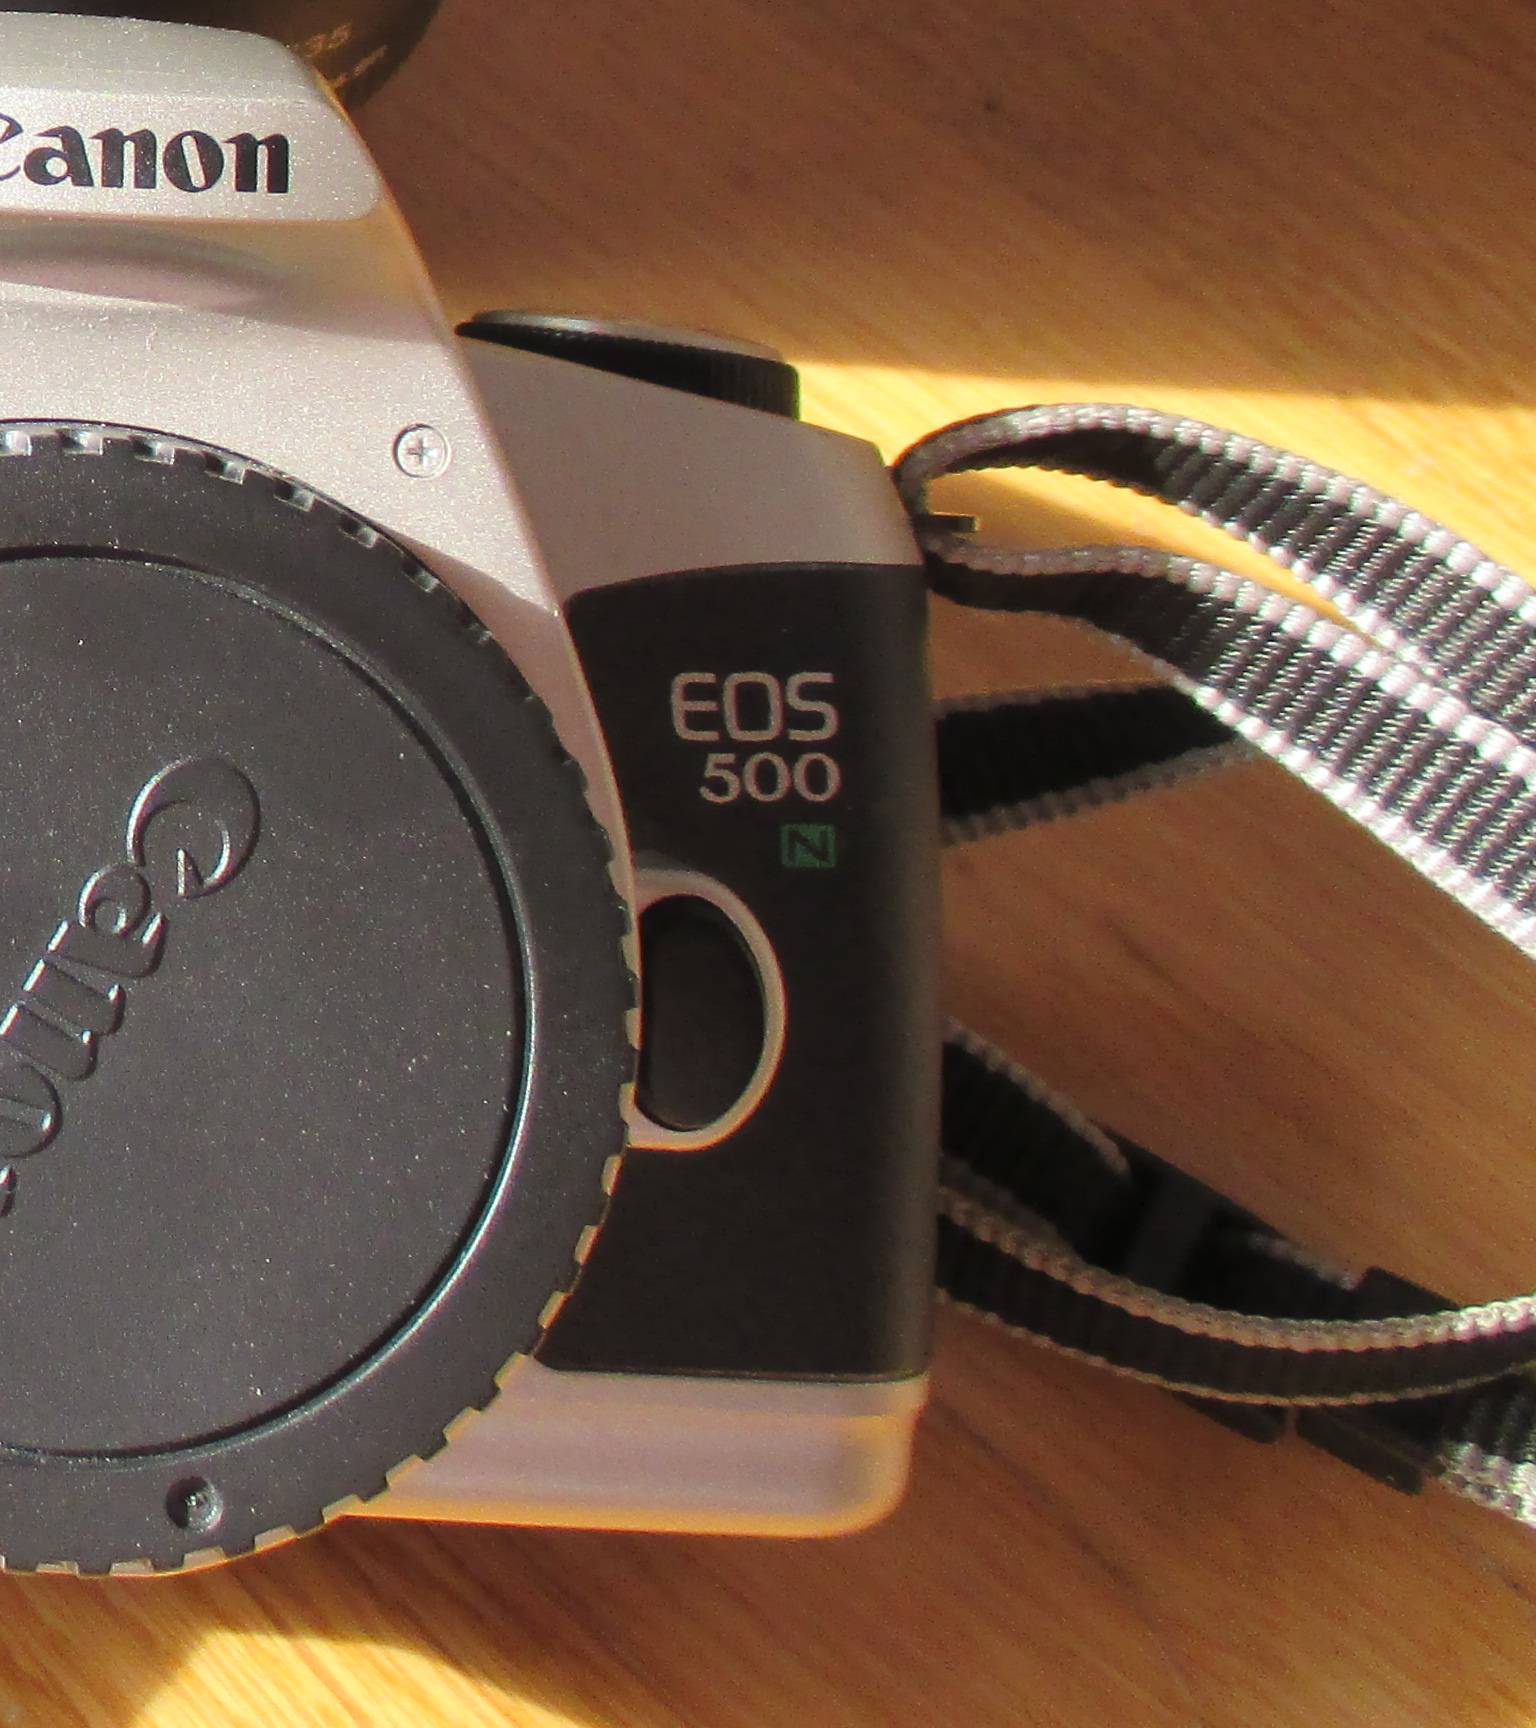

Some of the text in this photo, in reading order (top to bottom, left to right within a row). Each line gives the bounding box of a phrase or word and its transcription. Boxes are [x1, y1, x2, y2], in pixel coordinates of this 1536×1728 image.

[670, 671, 840, 742] EOS
[698, 752, 841, 804] 500
[785, 828, 832, 866] N
